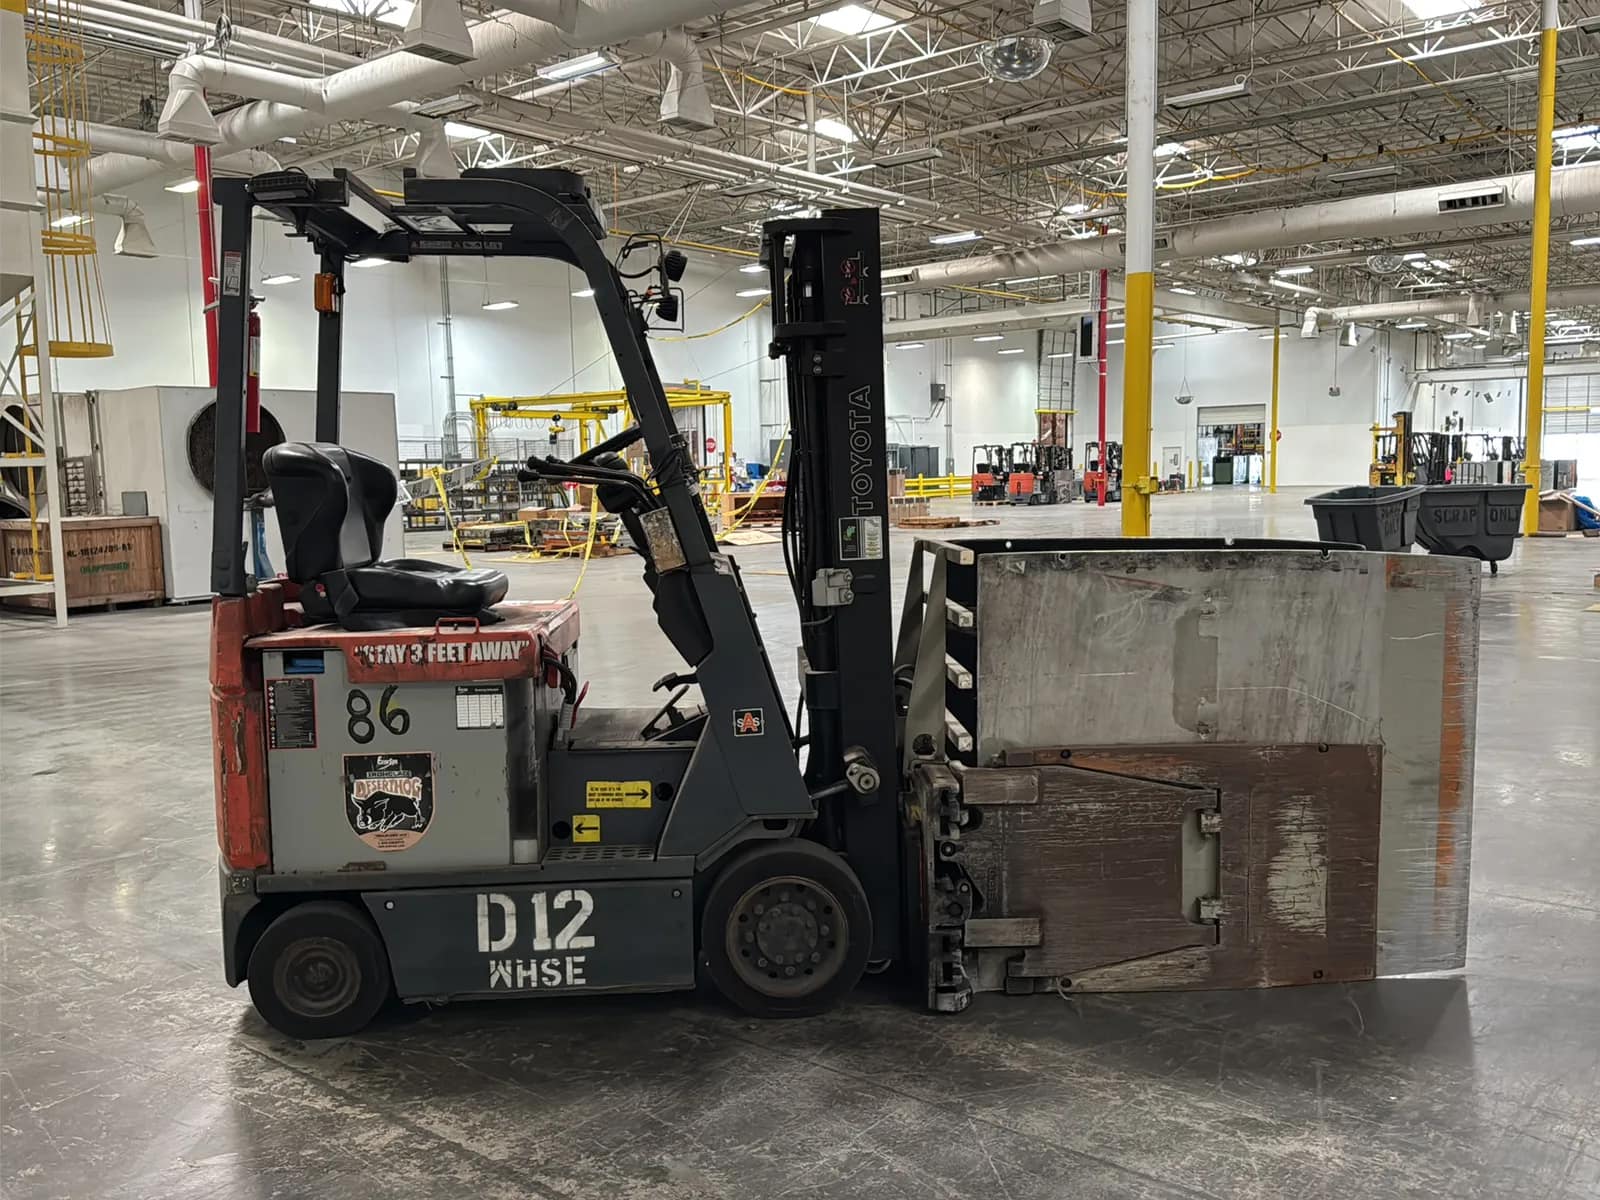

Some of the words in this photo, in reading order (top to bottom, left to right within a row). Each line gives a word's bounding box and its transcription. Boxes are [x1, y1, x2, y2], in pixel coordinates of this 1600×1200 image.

[849, 384, 874, 517] TOYOTA
[1433, 507, 1477, 524] SCRAP
[410, 643, 424, 664] 3
[427, 641, 468, 663] FEET
[346, 684, 410, 744] 86
[736, 711, 761, 732] SAS
[489, 955, 586, 989] WHSE
